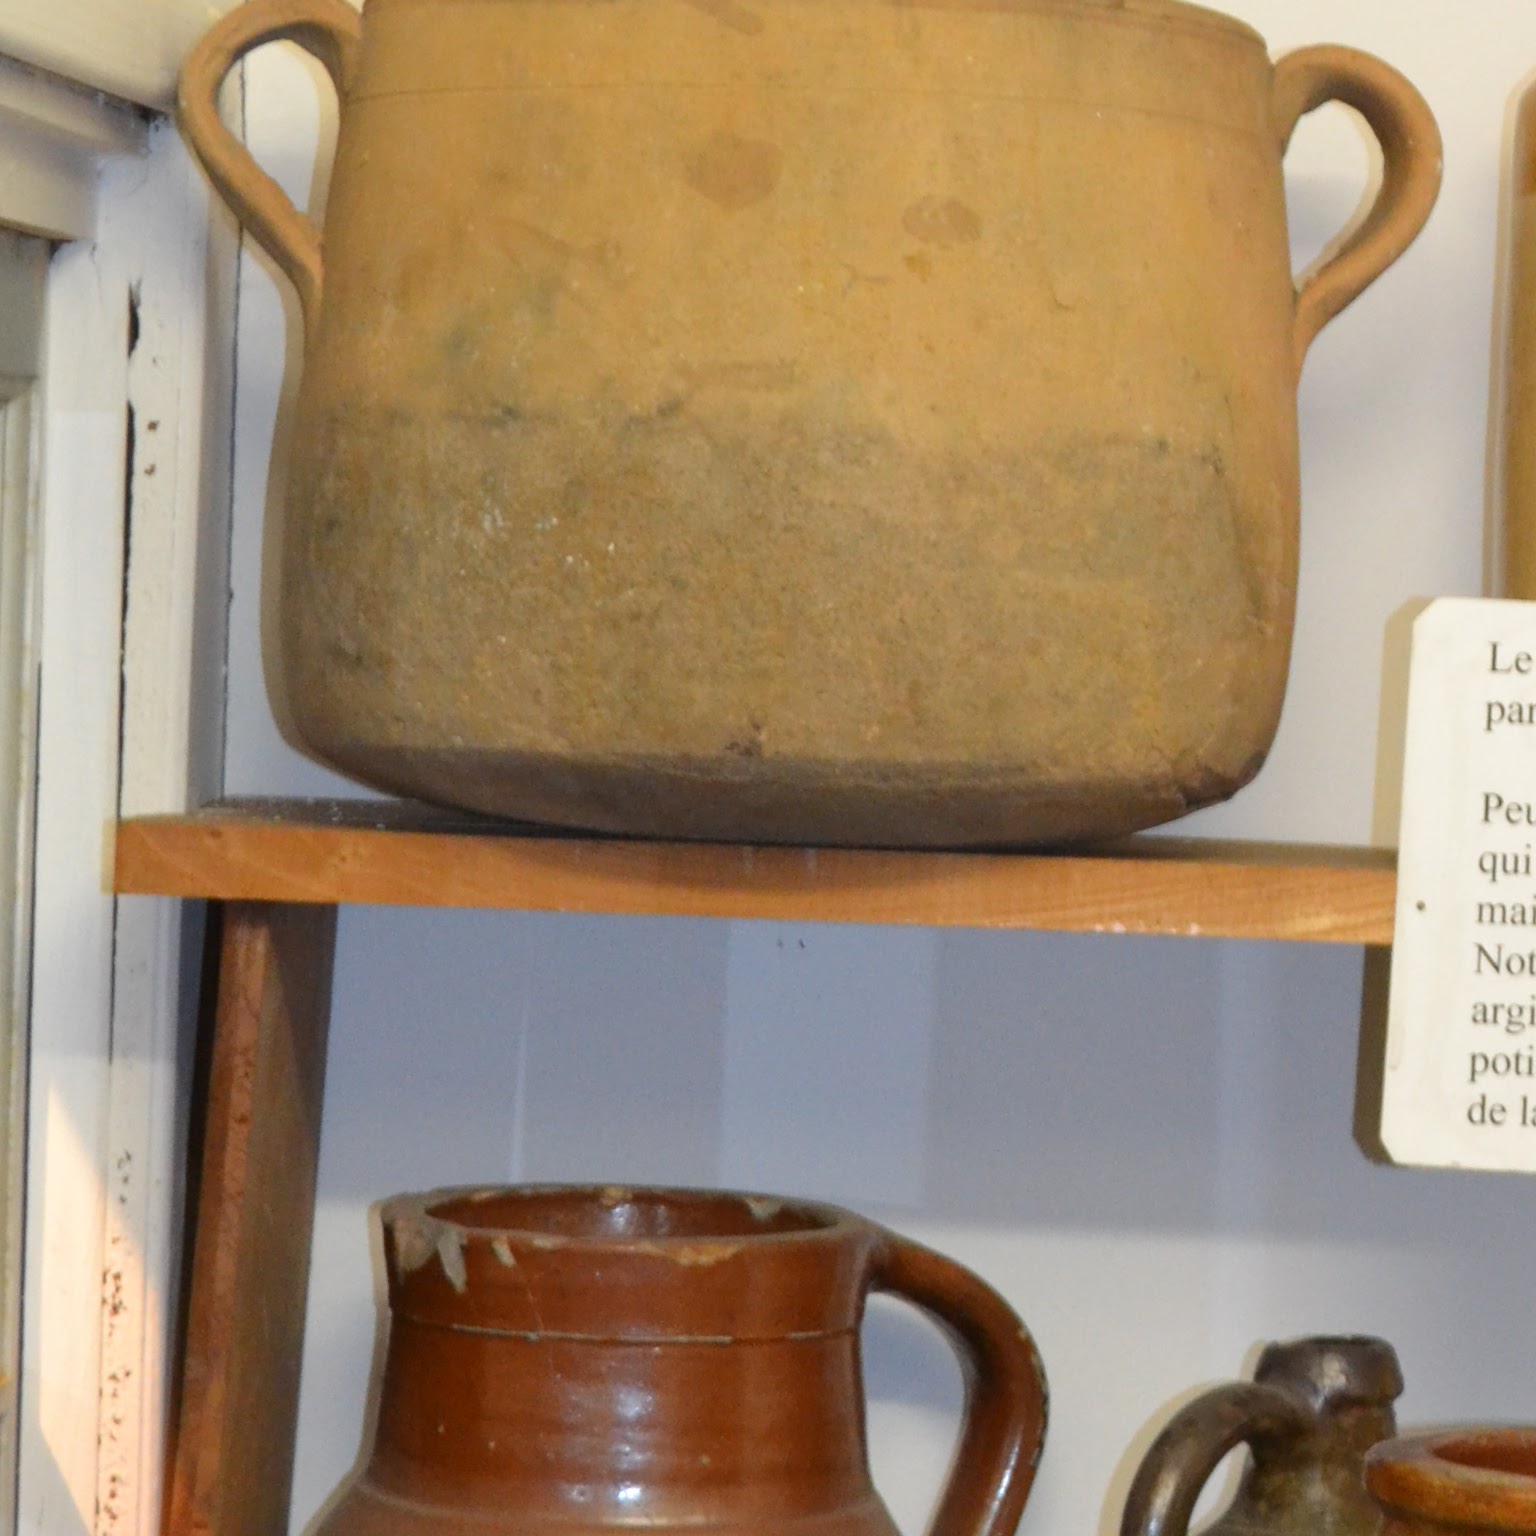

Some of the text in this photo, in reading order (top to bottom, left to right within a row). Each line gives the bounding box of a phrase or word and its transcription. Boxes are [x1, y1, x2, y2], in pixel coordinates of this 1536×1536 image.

[1489, 640, 1534, 676] Le
[1477, 843, 1532, 884] qui
[1465, 1092, 1508, 1127] de
